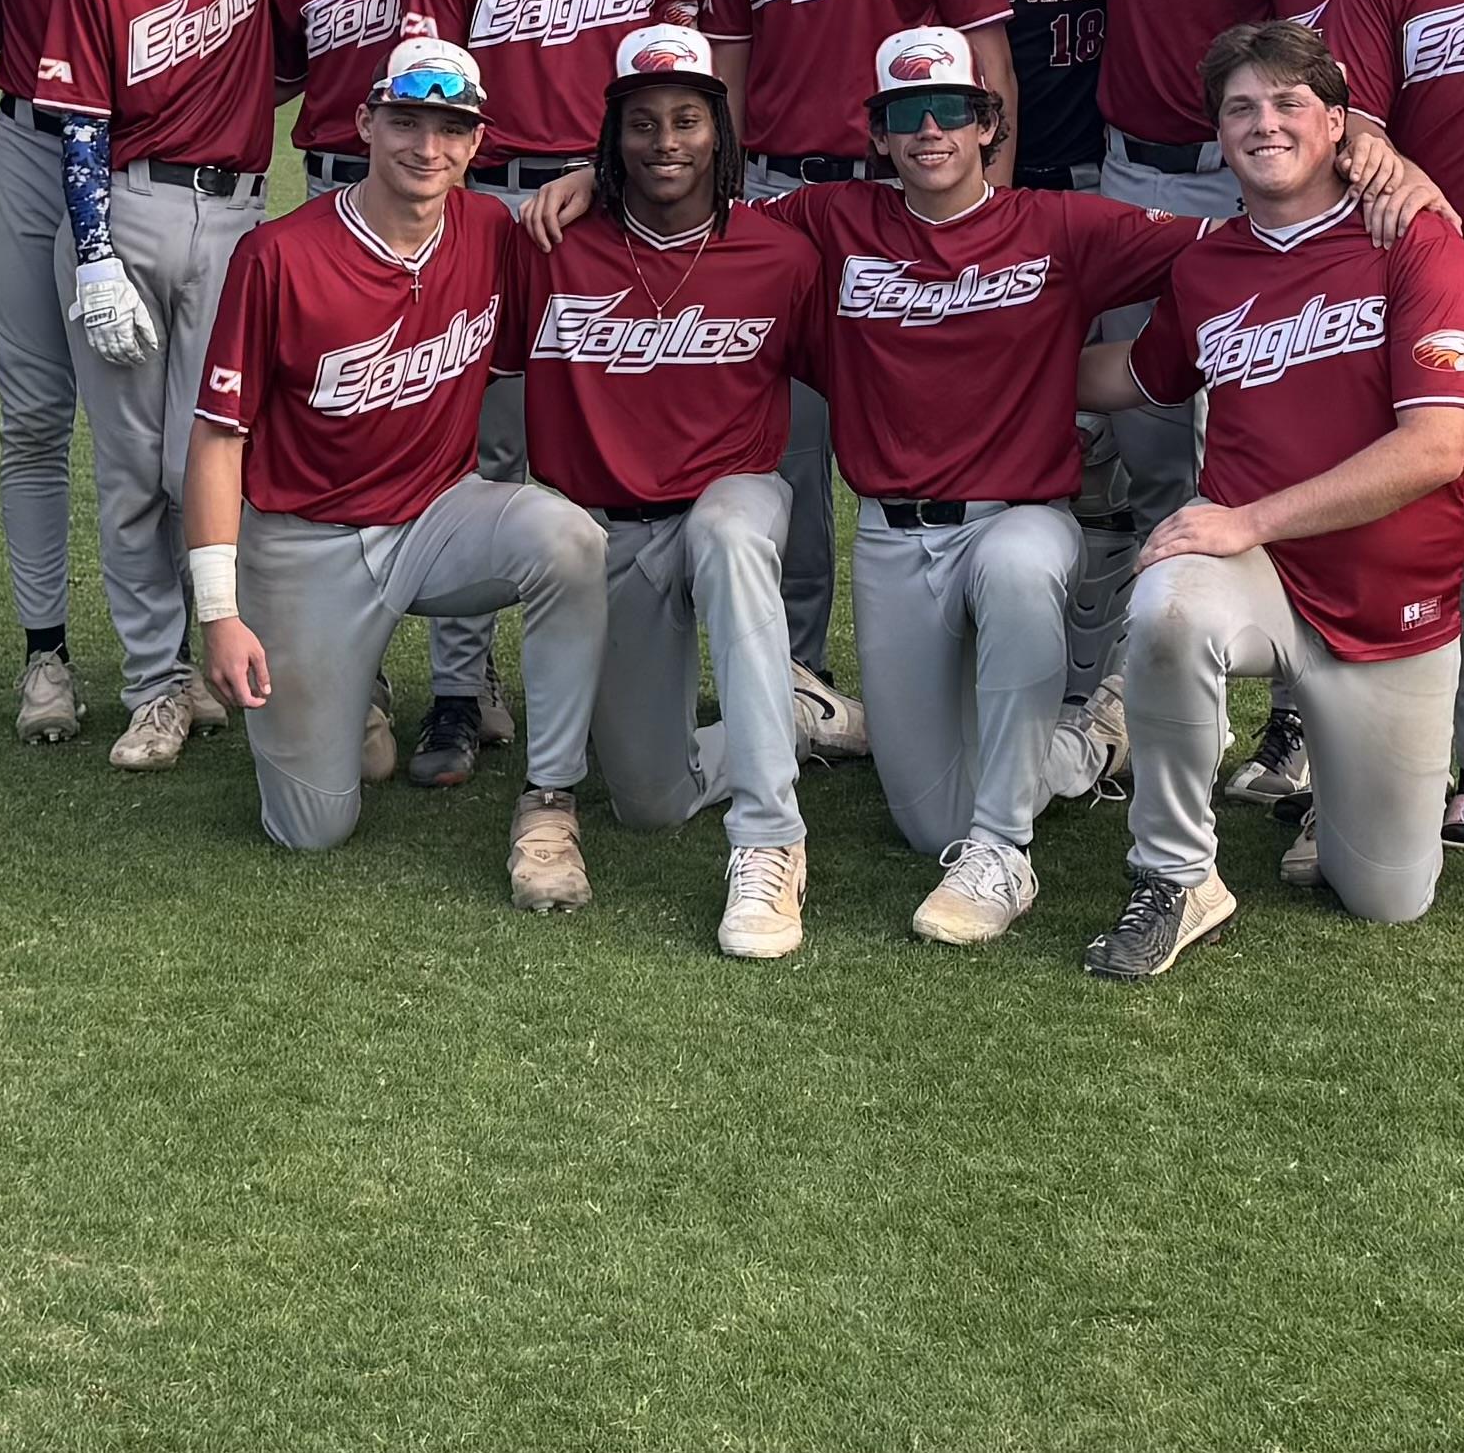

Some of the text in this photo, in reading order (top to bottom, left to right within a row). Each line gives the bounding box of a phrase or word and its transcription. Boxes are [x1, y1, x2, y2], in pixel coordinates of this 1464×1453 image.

[1050, 8, 1105, 66] 18
[531, 287, 776, 375] Eagles
[838, 255, 1050, 328] Eagles
[1195, 292, 1386, 393] Eagles
